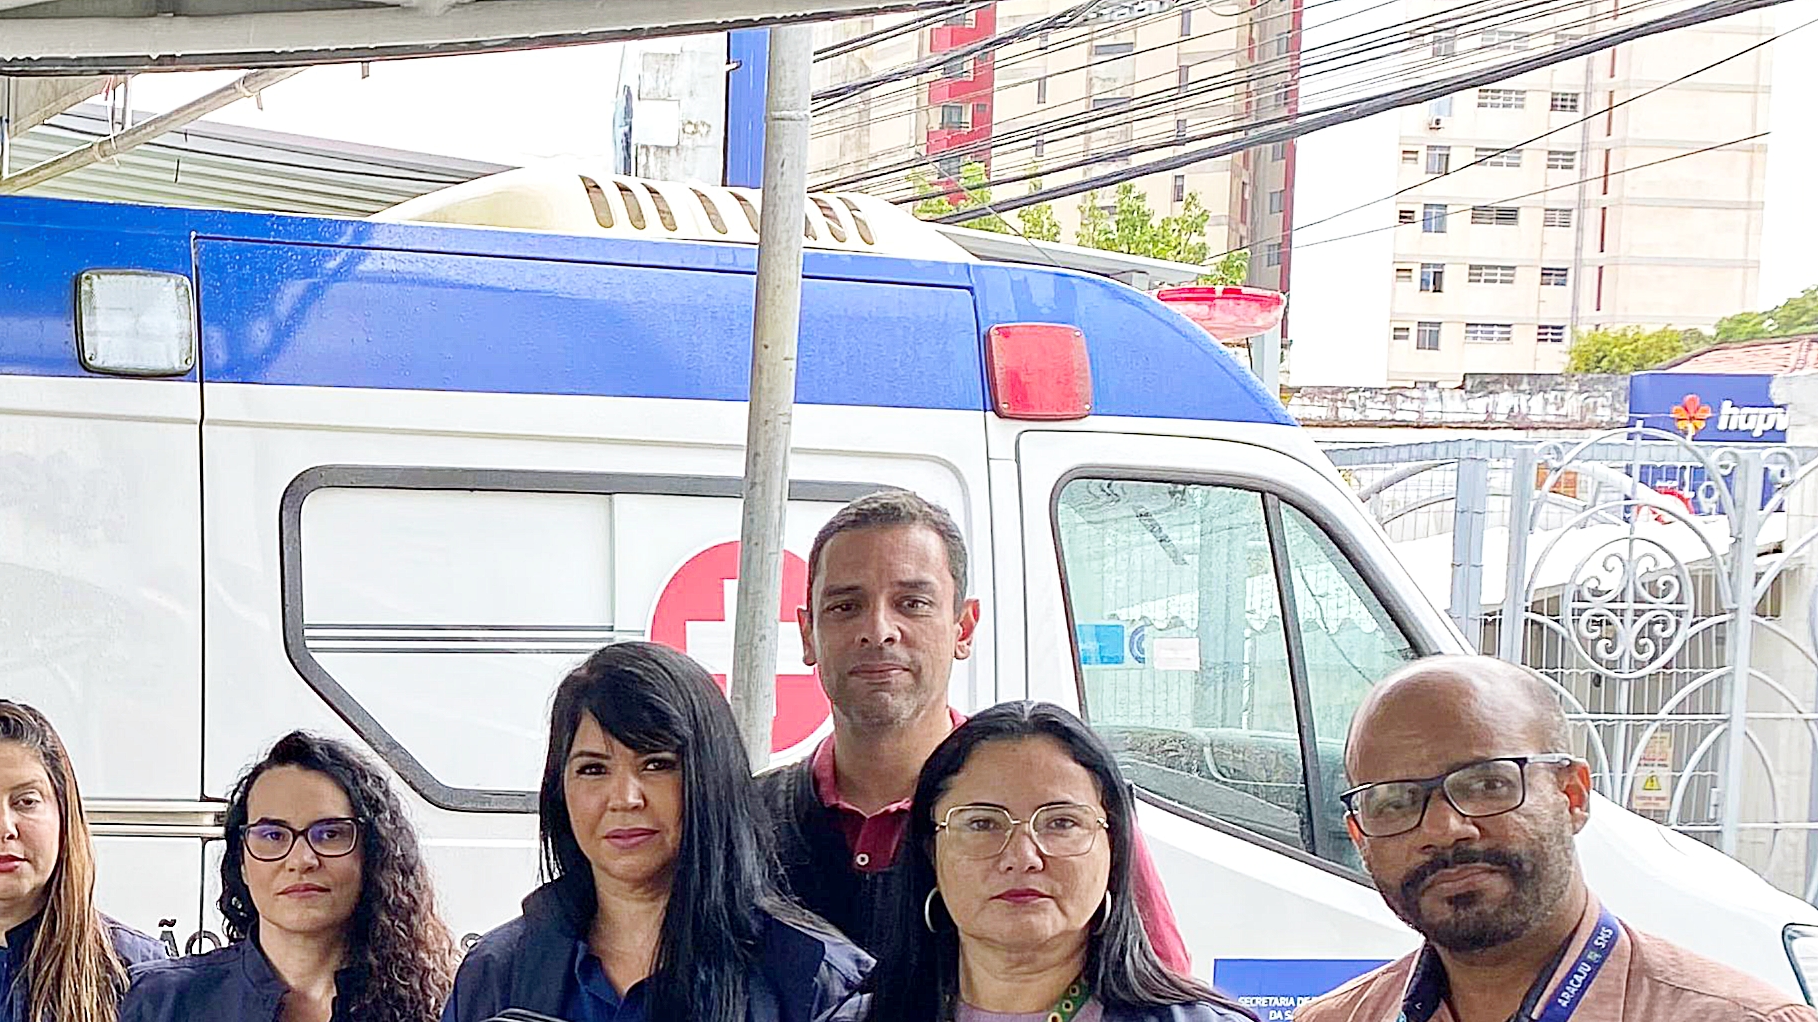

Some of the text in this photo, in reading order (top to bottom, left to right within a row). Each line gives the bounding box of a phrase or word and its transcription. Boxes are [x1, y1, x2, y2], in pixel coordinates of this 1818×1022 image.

[1557, 926, 1614, 1008] ARACAJU SMS
[1237, 996, 1296, 1007] SECRETARIA
[1269, 1009, 1284, 1021] DA
